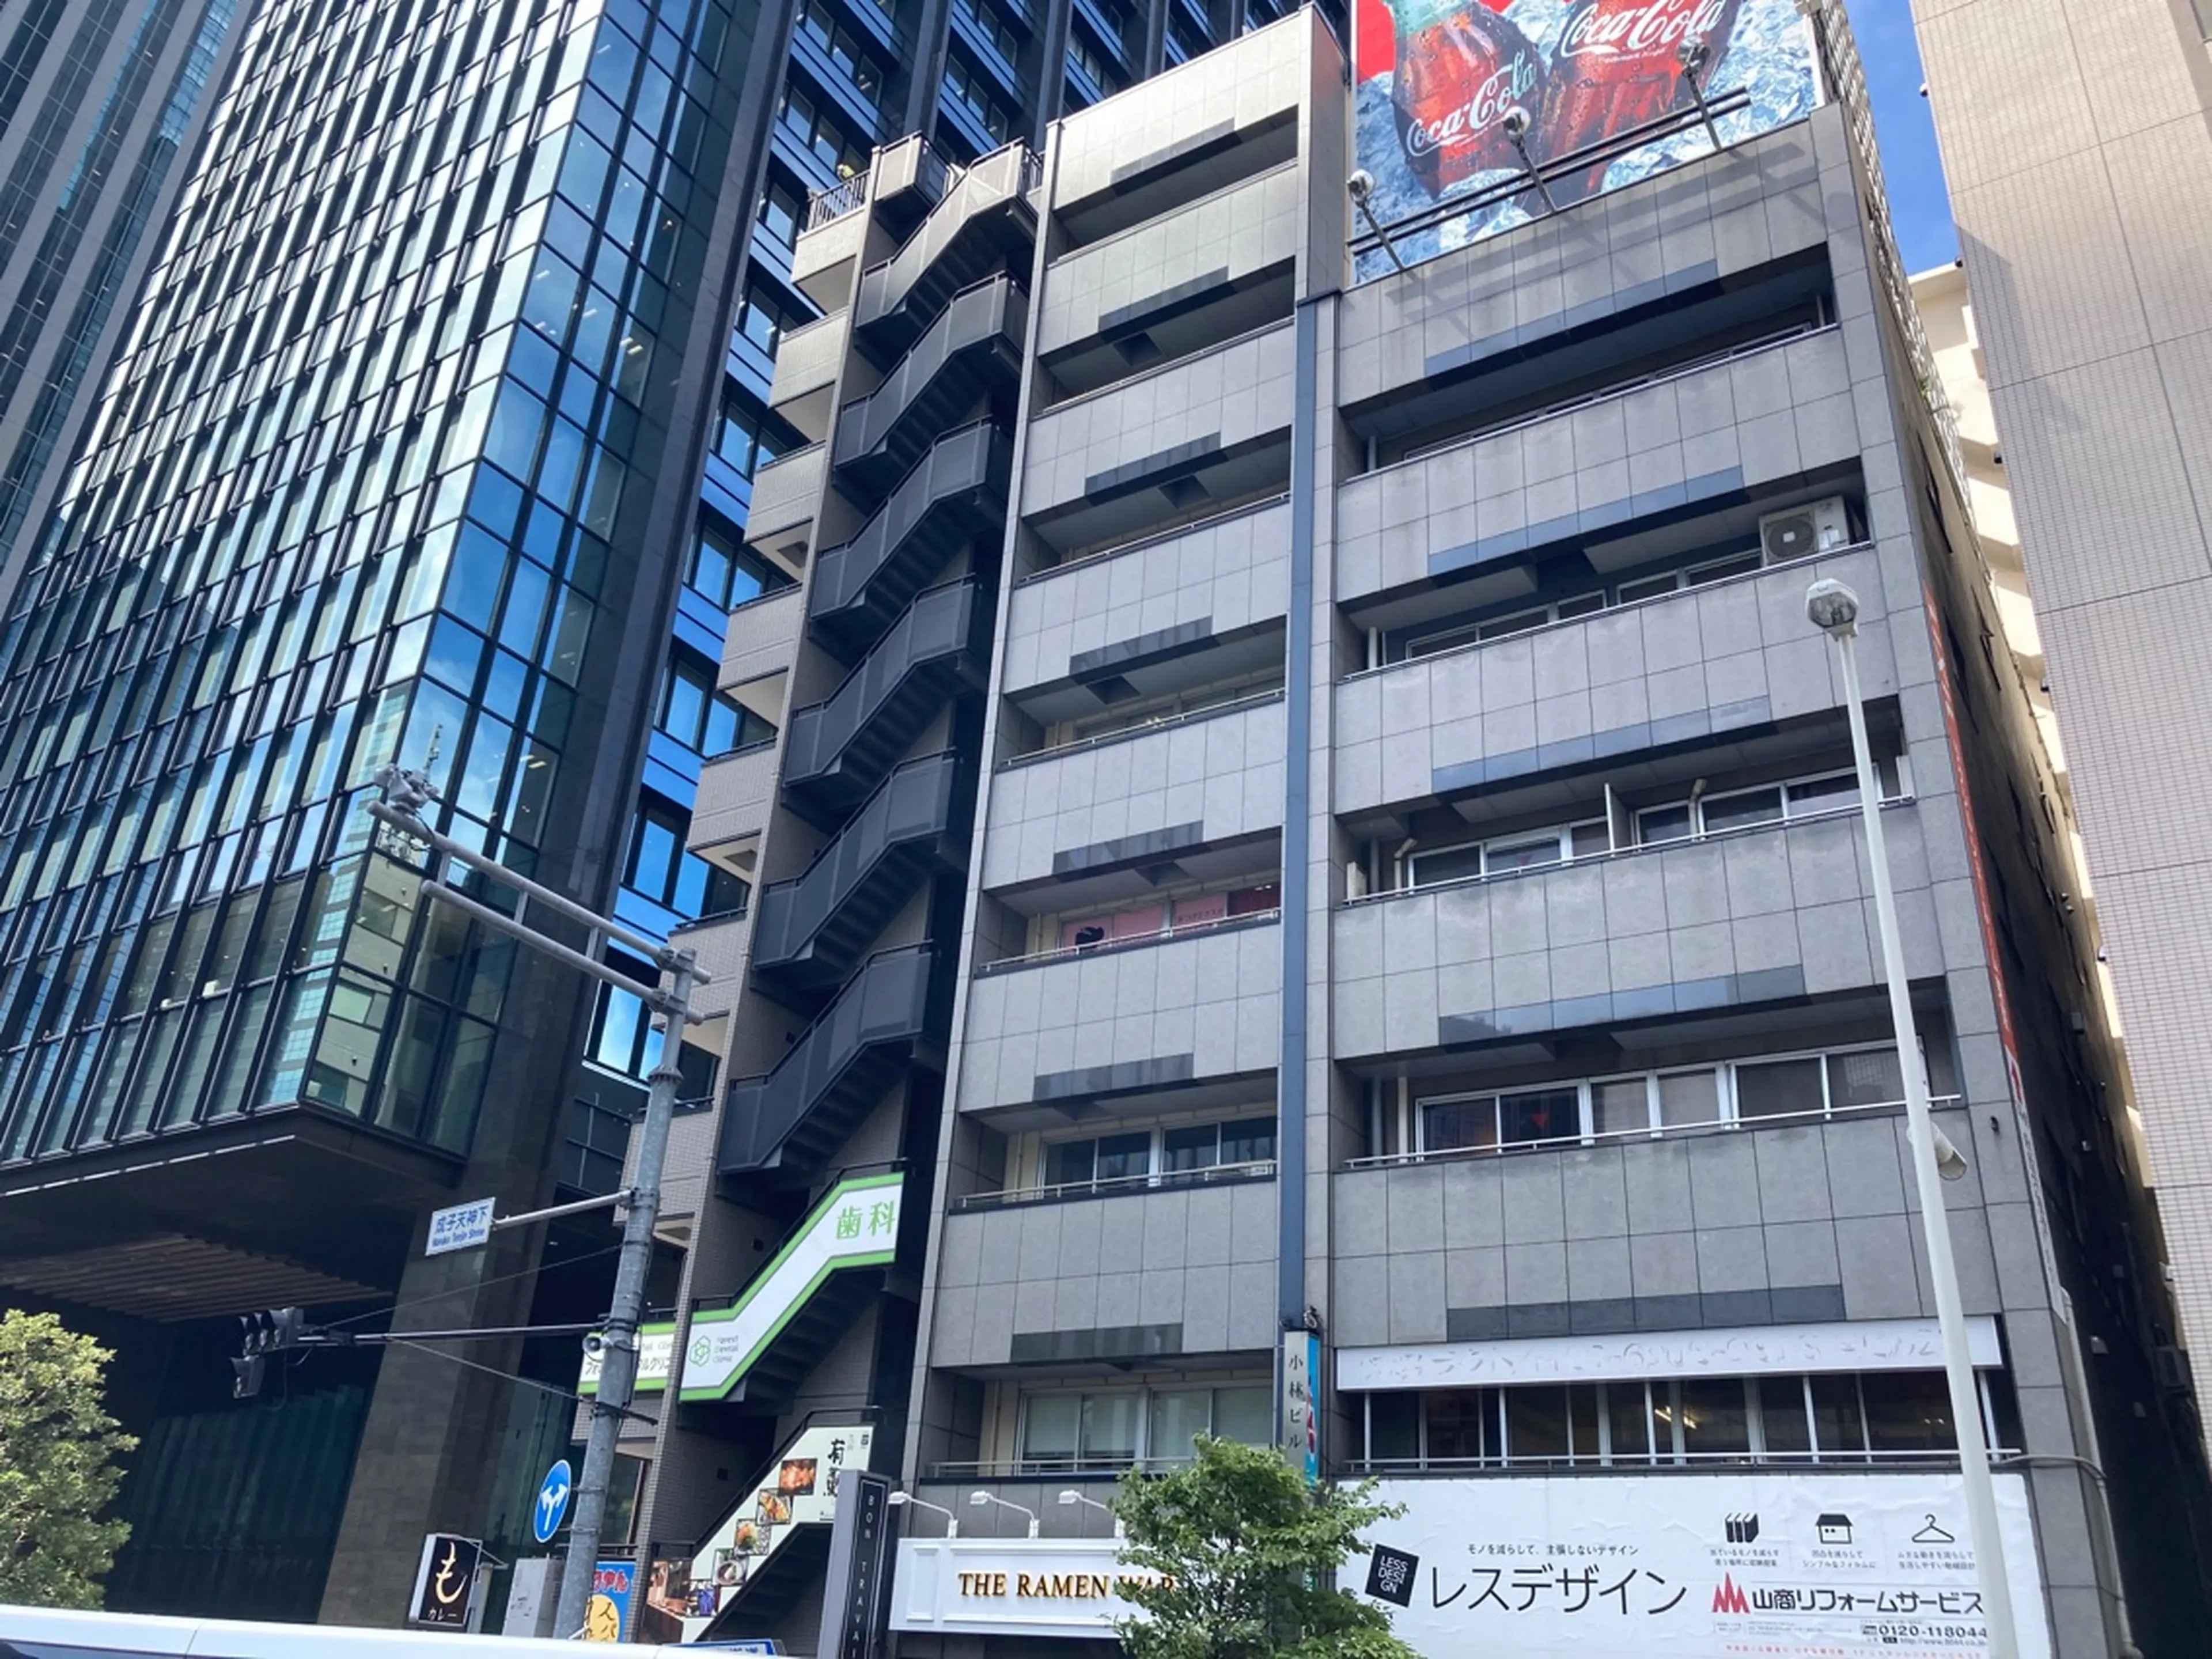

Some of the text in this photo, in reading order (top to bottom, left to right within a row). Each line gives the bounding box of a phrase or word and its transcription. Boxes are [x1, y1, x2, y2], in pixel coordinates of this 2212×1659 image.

[1406, 48, 1537, 157] Coca-Cola
[436, 1205, 489, 1233] 成子天神下
[836, 1200, 895, 1240] 歯科
[1289, 1354, 1303, 1449] 小林ビル
[435, 1541, 468, 1604] も
[1381, 1555, 1408, 1573] LESS
[958, 1573, 1007, 1597] THE
[1017, 1573, 1110, 1599] RAMEN
[1432, 1563, 1687, 1615] レスデザイン
[1752, 1588, 1985, 1614] 山商リフォームサービス
[428, 1608, 458, 1621] カレー
